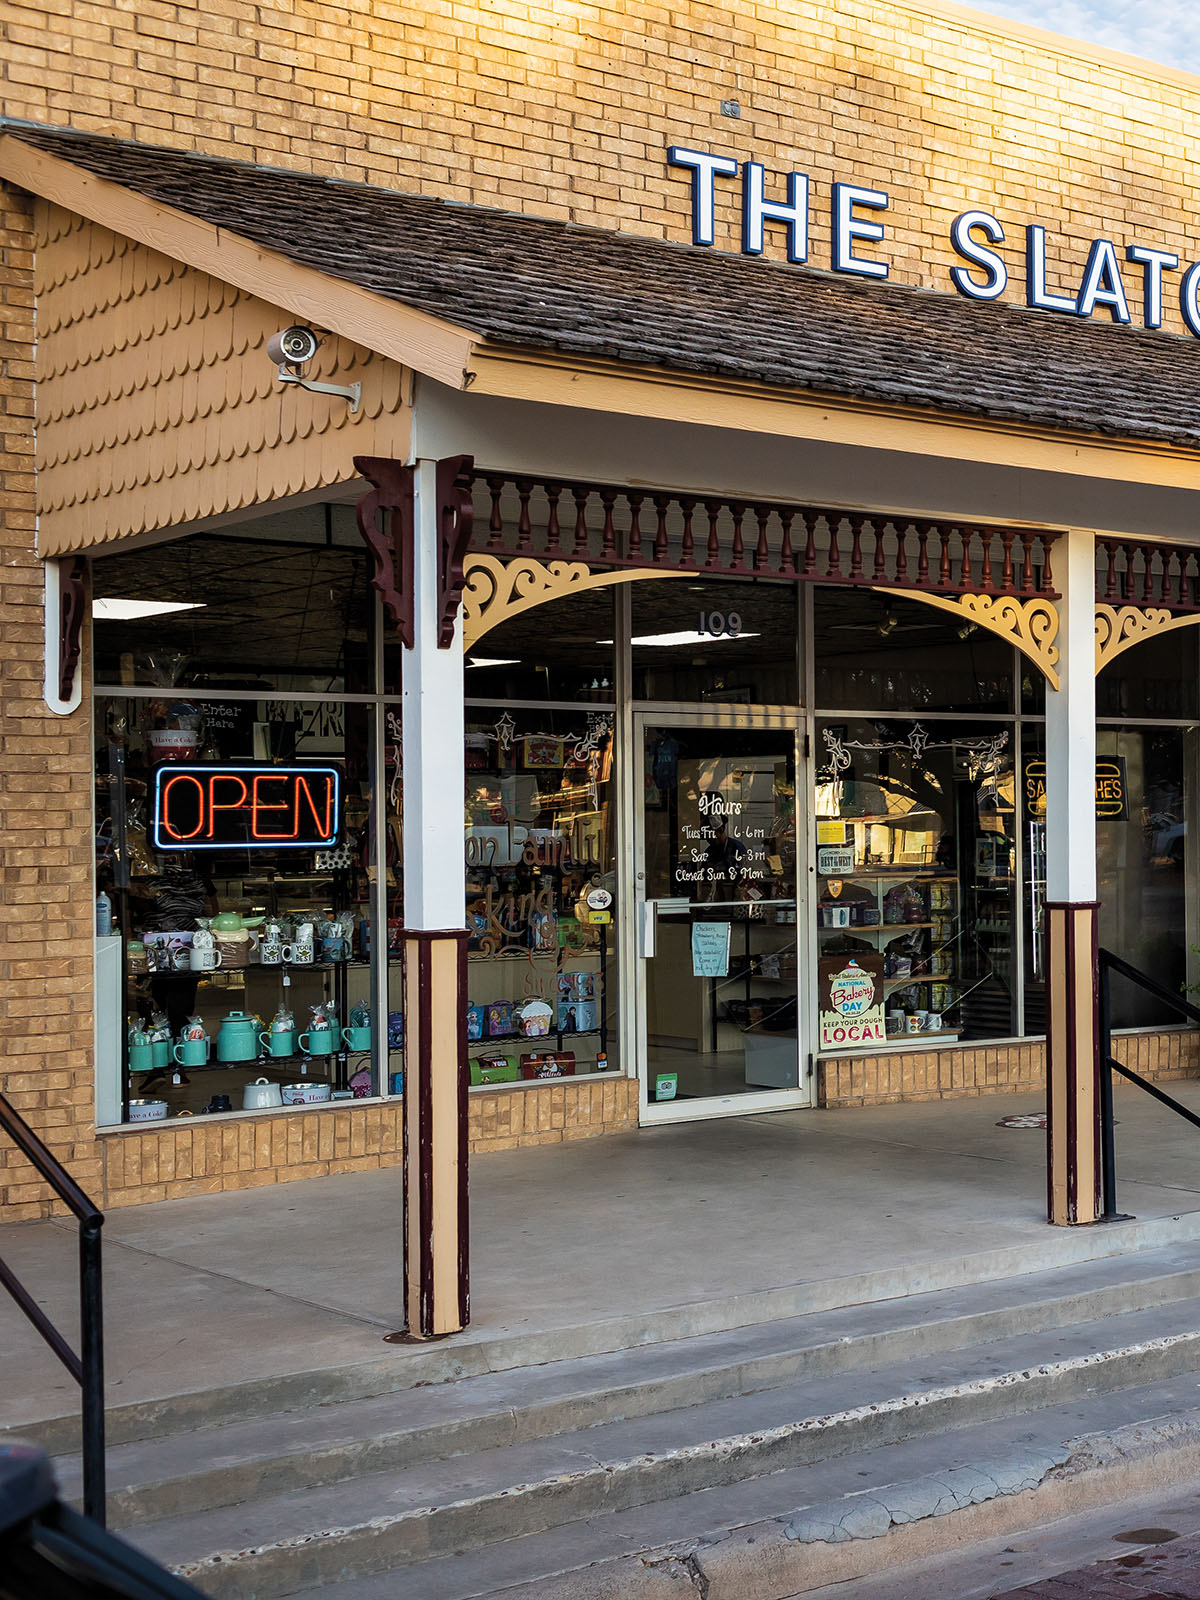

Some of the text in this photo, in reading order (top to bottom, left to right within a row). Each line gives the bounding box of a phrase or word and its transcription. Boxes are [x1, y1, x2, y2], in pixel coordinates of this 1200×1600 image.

[667, 145, 890, 278] THE
[696, 611, 742, 637] 109
[206, 717, 235, 729] Here
[163, 775, 332, 839] OPEN
[698, 794, 742, 815] Hours
[675, 866, 764, 881] Closed Sun & Mon
[831, 986, 874, 1006] Bakery
[842, 1002, 863, 1012] DAY
[823, 1024, 884, 1044] LOCAL
